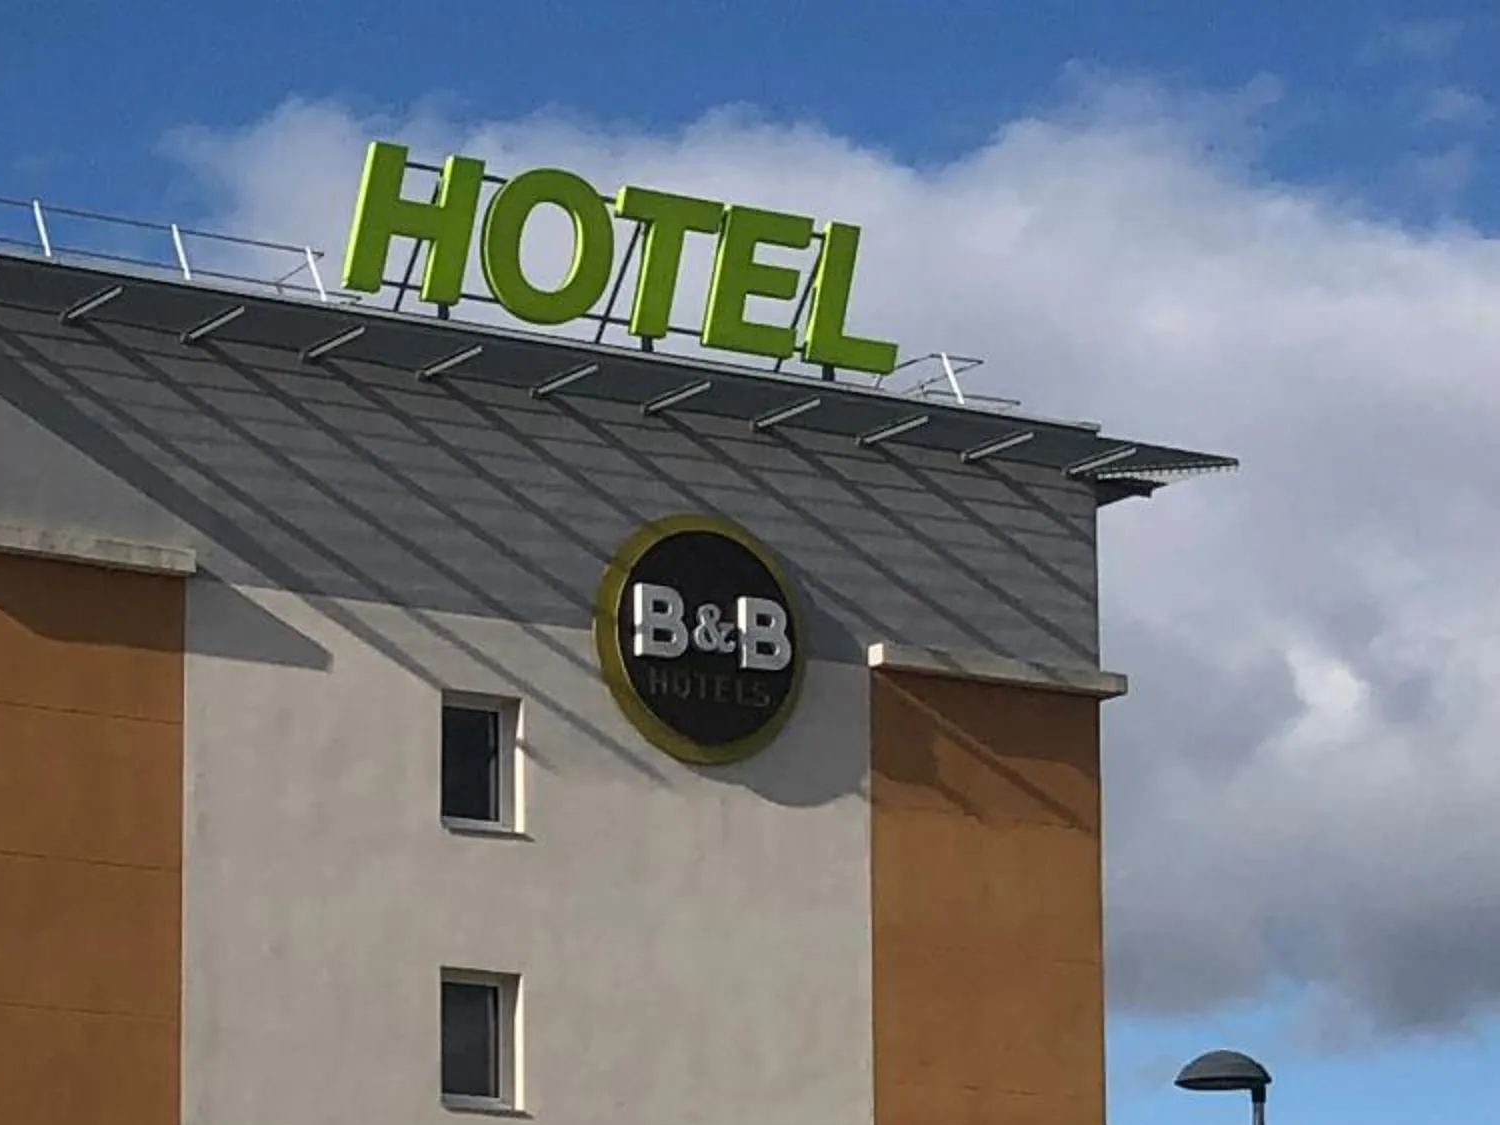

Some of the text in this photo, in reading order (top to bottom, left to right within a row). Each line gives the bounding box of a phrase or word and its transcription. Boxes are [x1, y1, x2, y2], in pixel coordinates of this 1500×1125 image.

[341, 141, 898, 375] HOTEL
[633, 582, 792, 671] B&B
[649, 665, 771, 707] HOTELS
